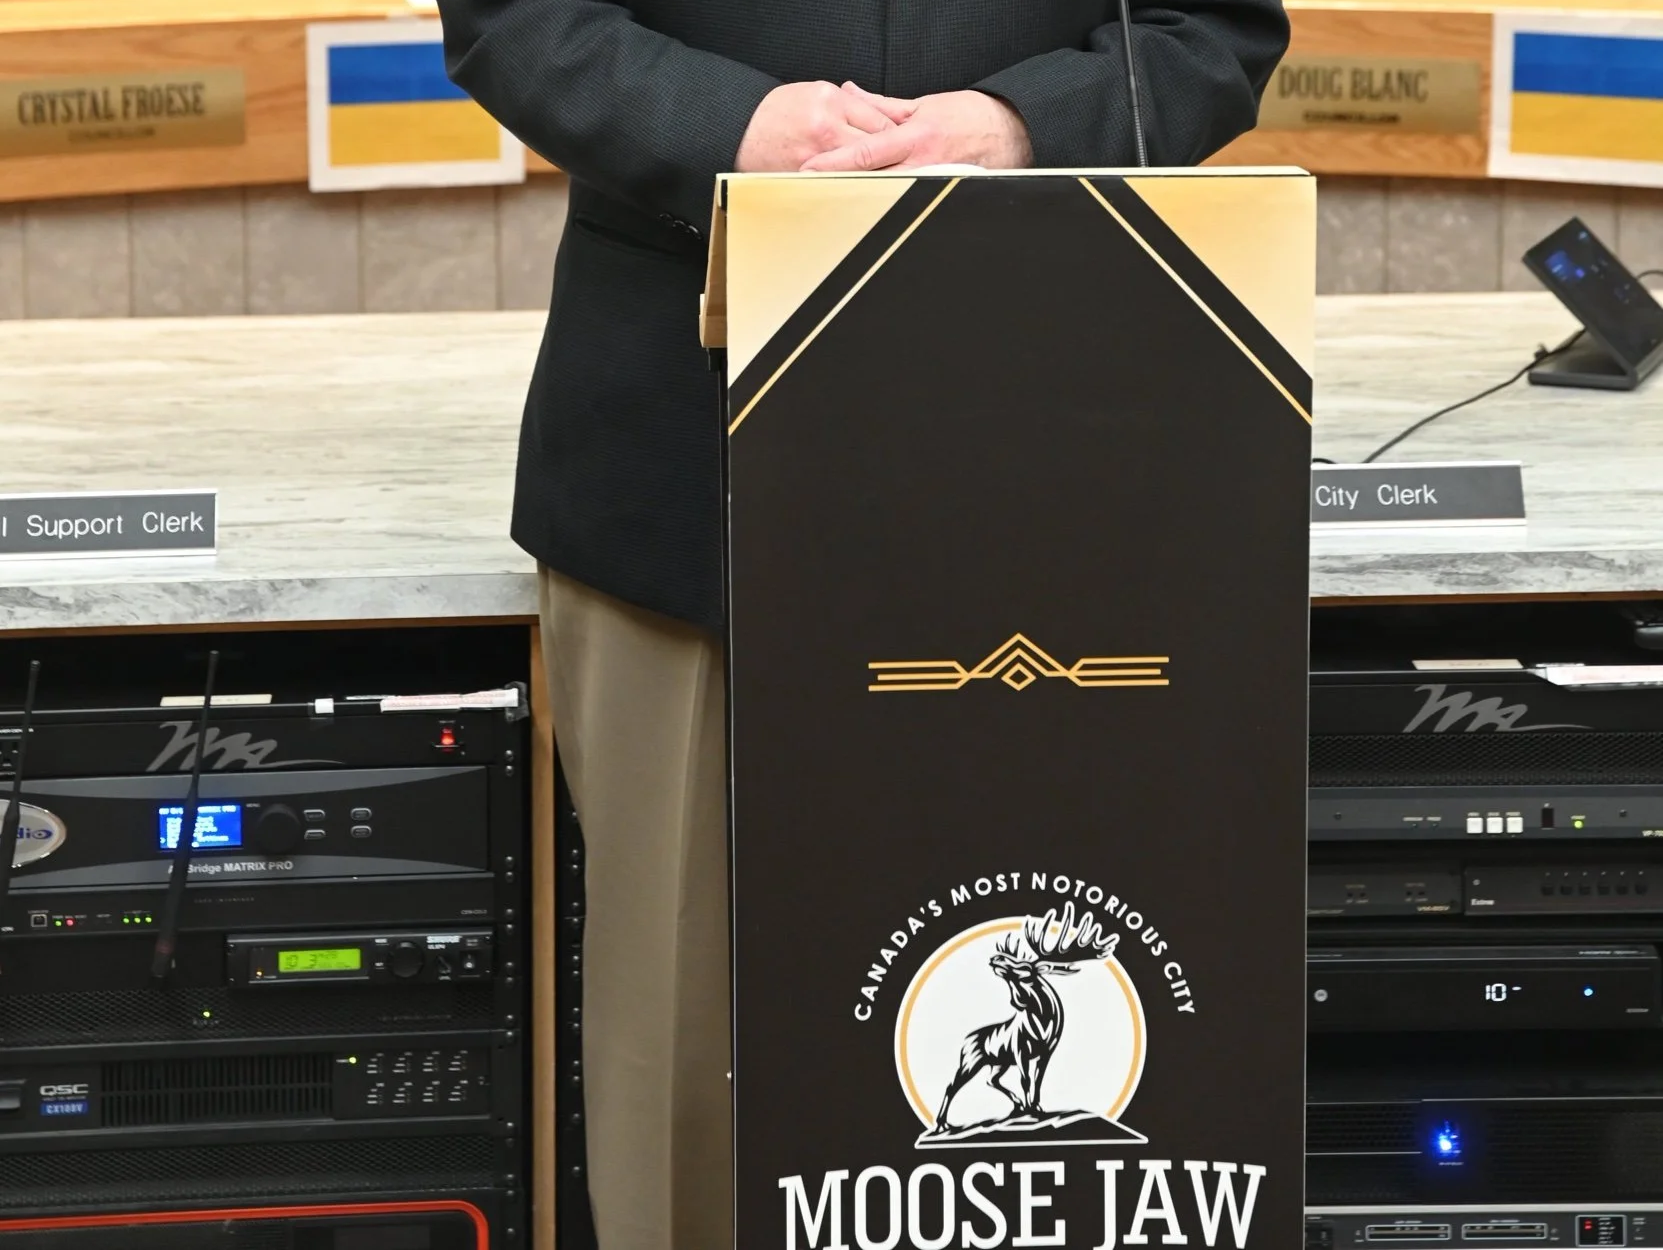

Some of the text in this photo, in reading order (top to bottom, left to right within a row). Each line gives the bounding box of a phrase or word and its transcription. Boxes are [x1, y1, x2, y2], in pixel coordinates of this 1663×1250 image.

[1278, 64, 1430, 103] DOUG BLANC
[17, 81, 206, 127] CRYSTAL FROESE
[1315, 484, 1438, 510] City Clerk
[26, 514, 123, 539] Support
[142, 511, 204, 533] Clerk
[223, 861, 266, 872] MATRIX
[268, 860, 294, 871] PRO
[855, 872, 1196, 1021] CANADA'S MOST NOTORIOUS CITY
[40, 1083, 88, 1096] QSC
[778, 1159, 1267, 1250] MOOSE JAW
